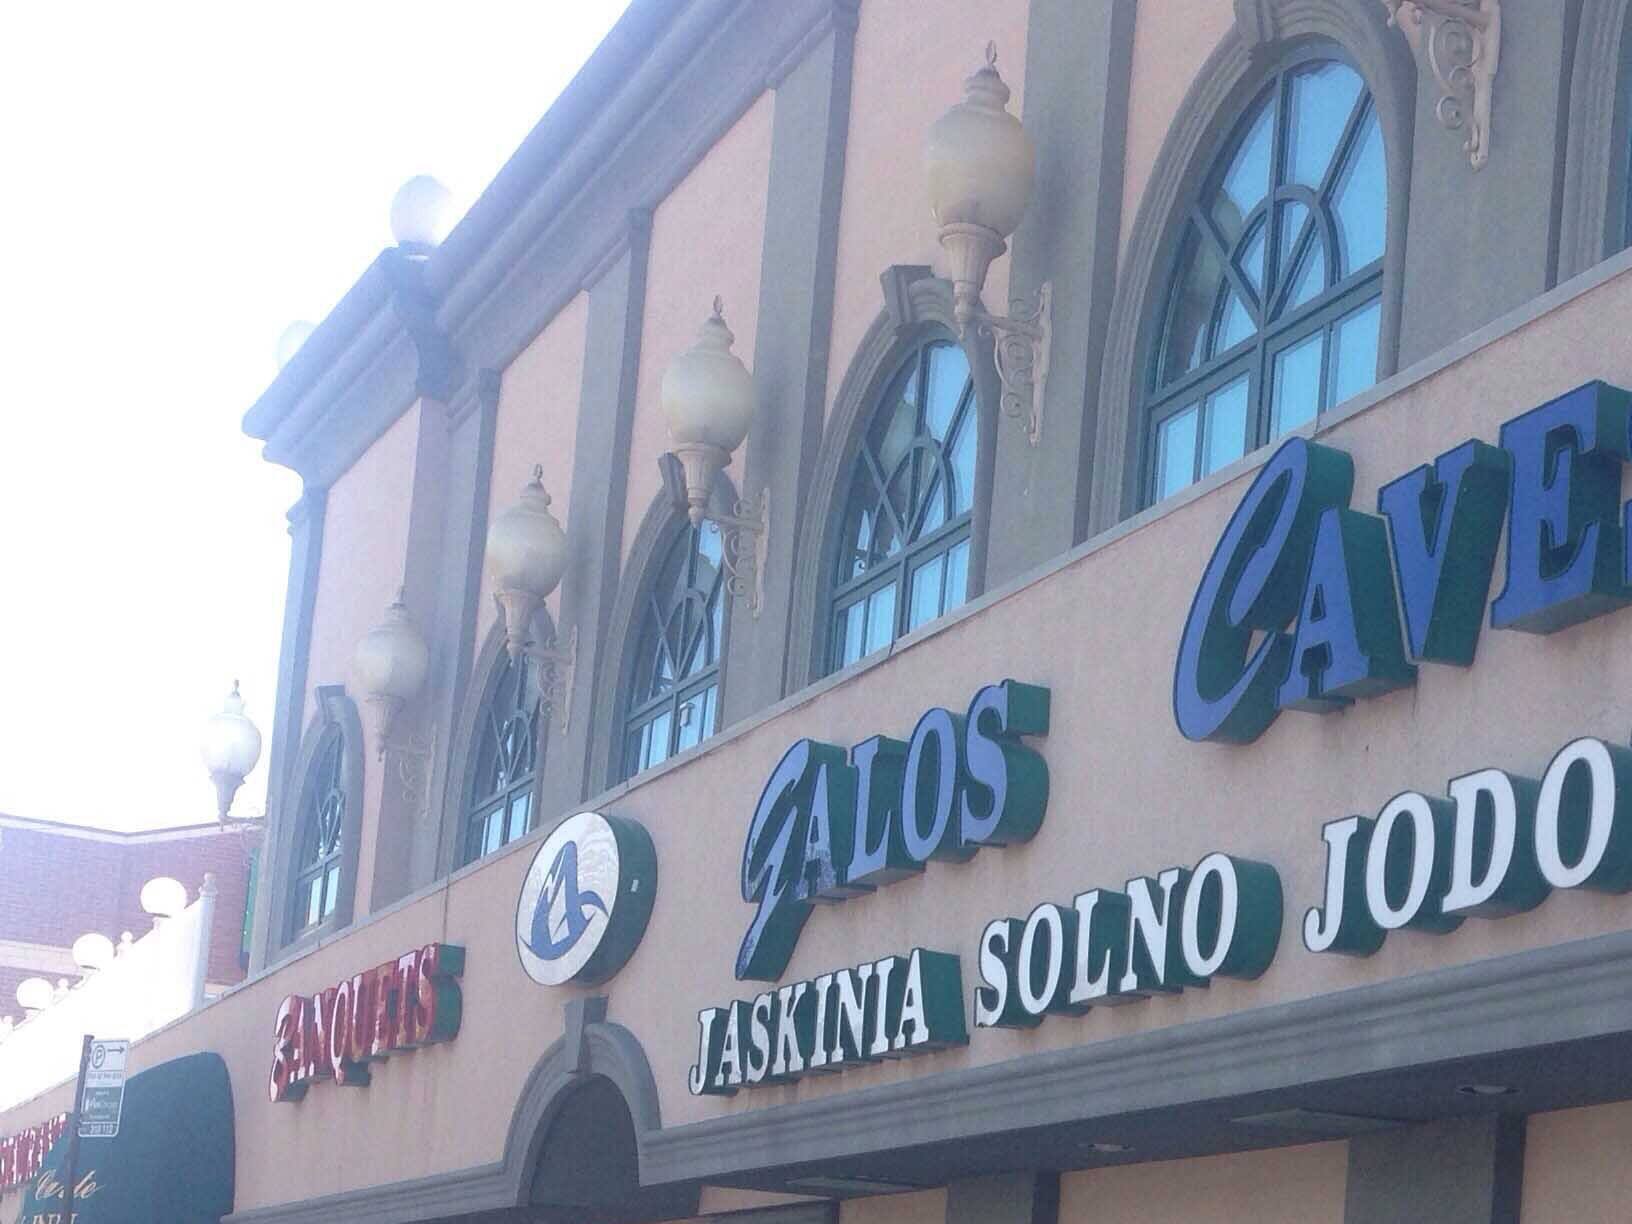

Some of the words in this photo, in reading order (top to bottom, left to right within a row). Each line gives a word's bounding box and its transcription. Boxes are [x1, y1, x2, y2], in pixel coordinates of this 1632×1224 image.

[735, 679, 1008, 981] GALOS
[269, 942, 442, 1102] BANQUETS
[688, 948, 932, 1096] JASKINIA
[975, 852, 1242, 1028] SOLNO
